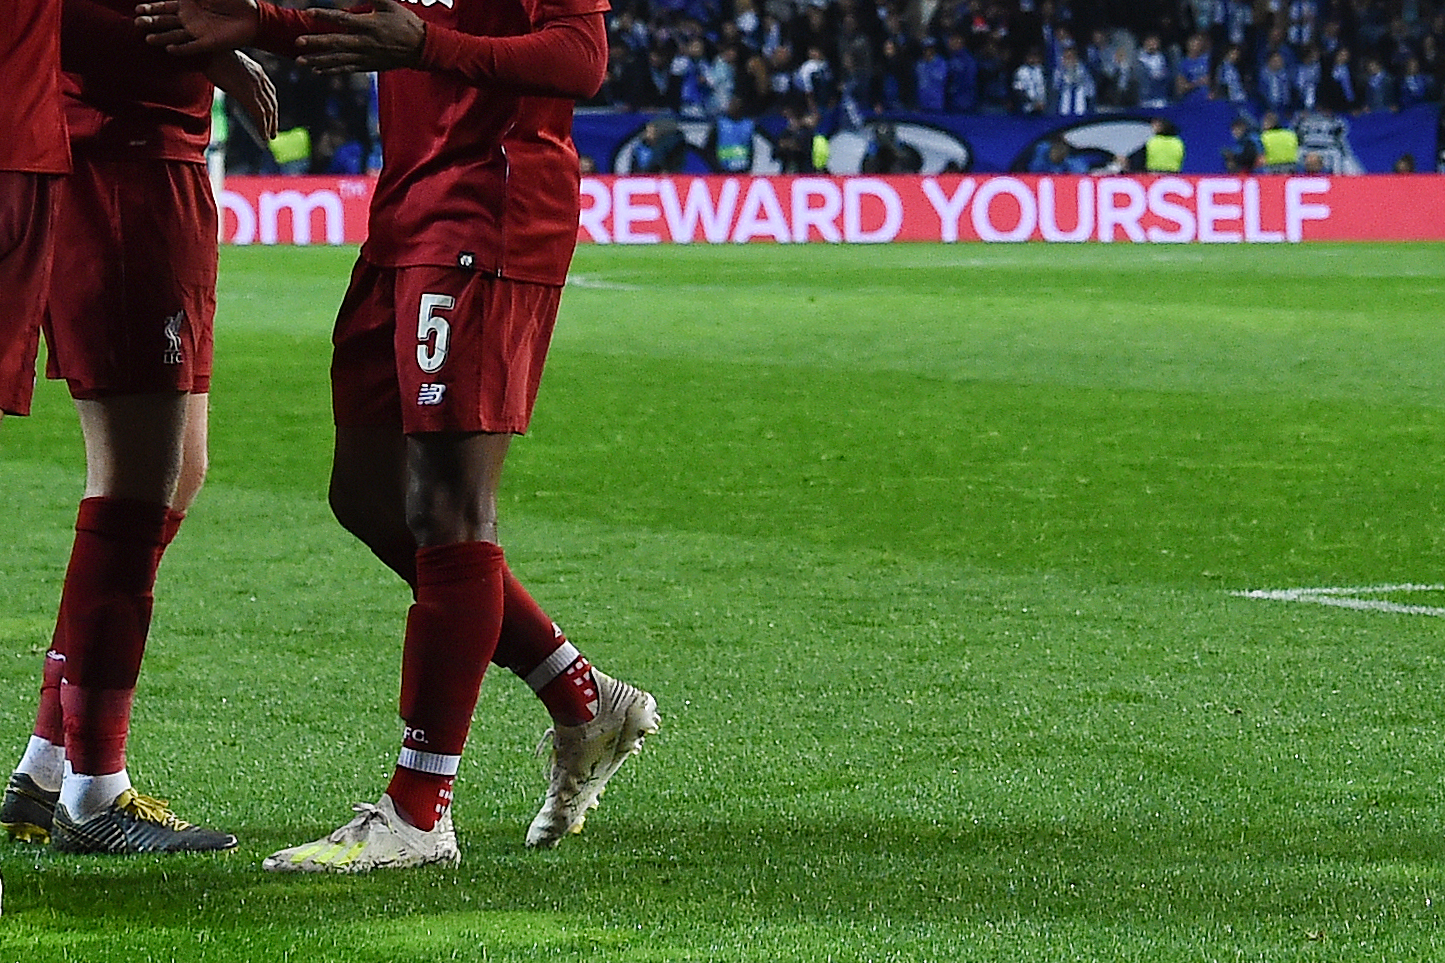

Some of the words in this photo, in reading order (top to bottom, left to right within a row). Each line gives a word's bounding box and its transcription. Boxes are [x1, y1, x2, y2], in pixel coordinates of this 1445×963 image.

[579, 177, 904, 245] REWARD
[920, 176, 1332, 244] YOURSELF
[416, 293, 456, 374] 5
